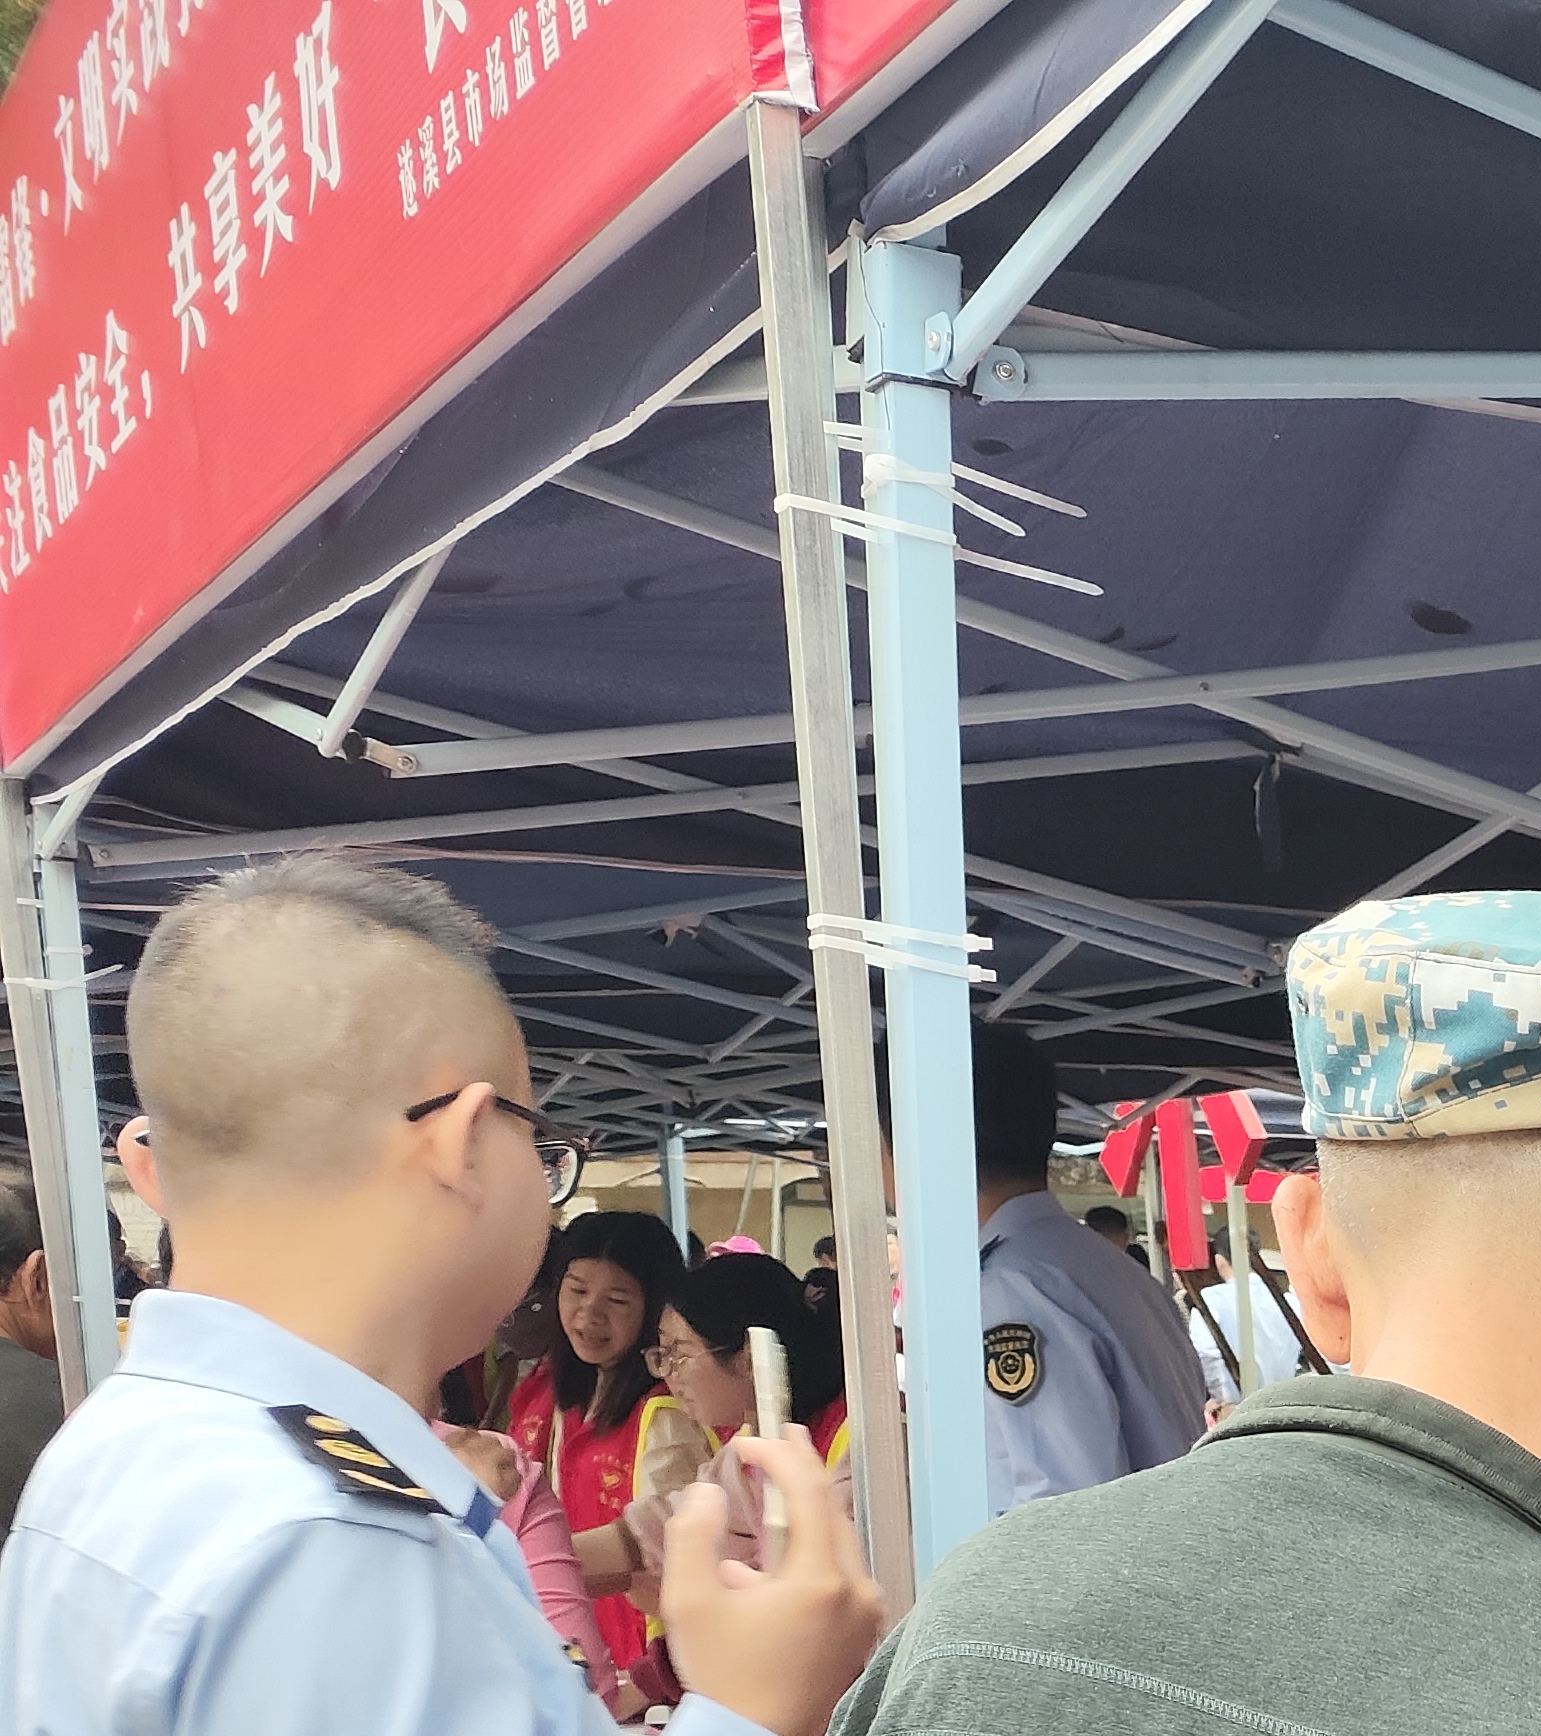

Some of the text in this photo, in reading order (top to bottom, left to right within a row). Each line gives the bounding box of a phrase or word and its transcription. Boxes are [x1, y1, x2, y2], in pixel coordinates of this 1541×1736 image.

[397, 0, 615, 220] 遂溪县市场监督
